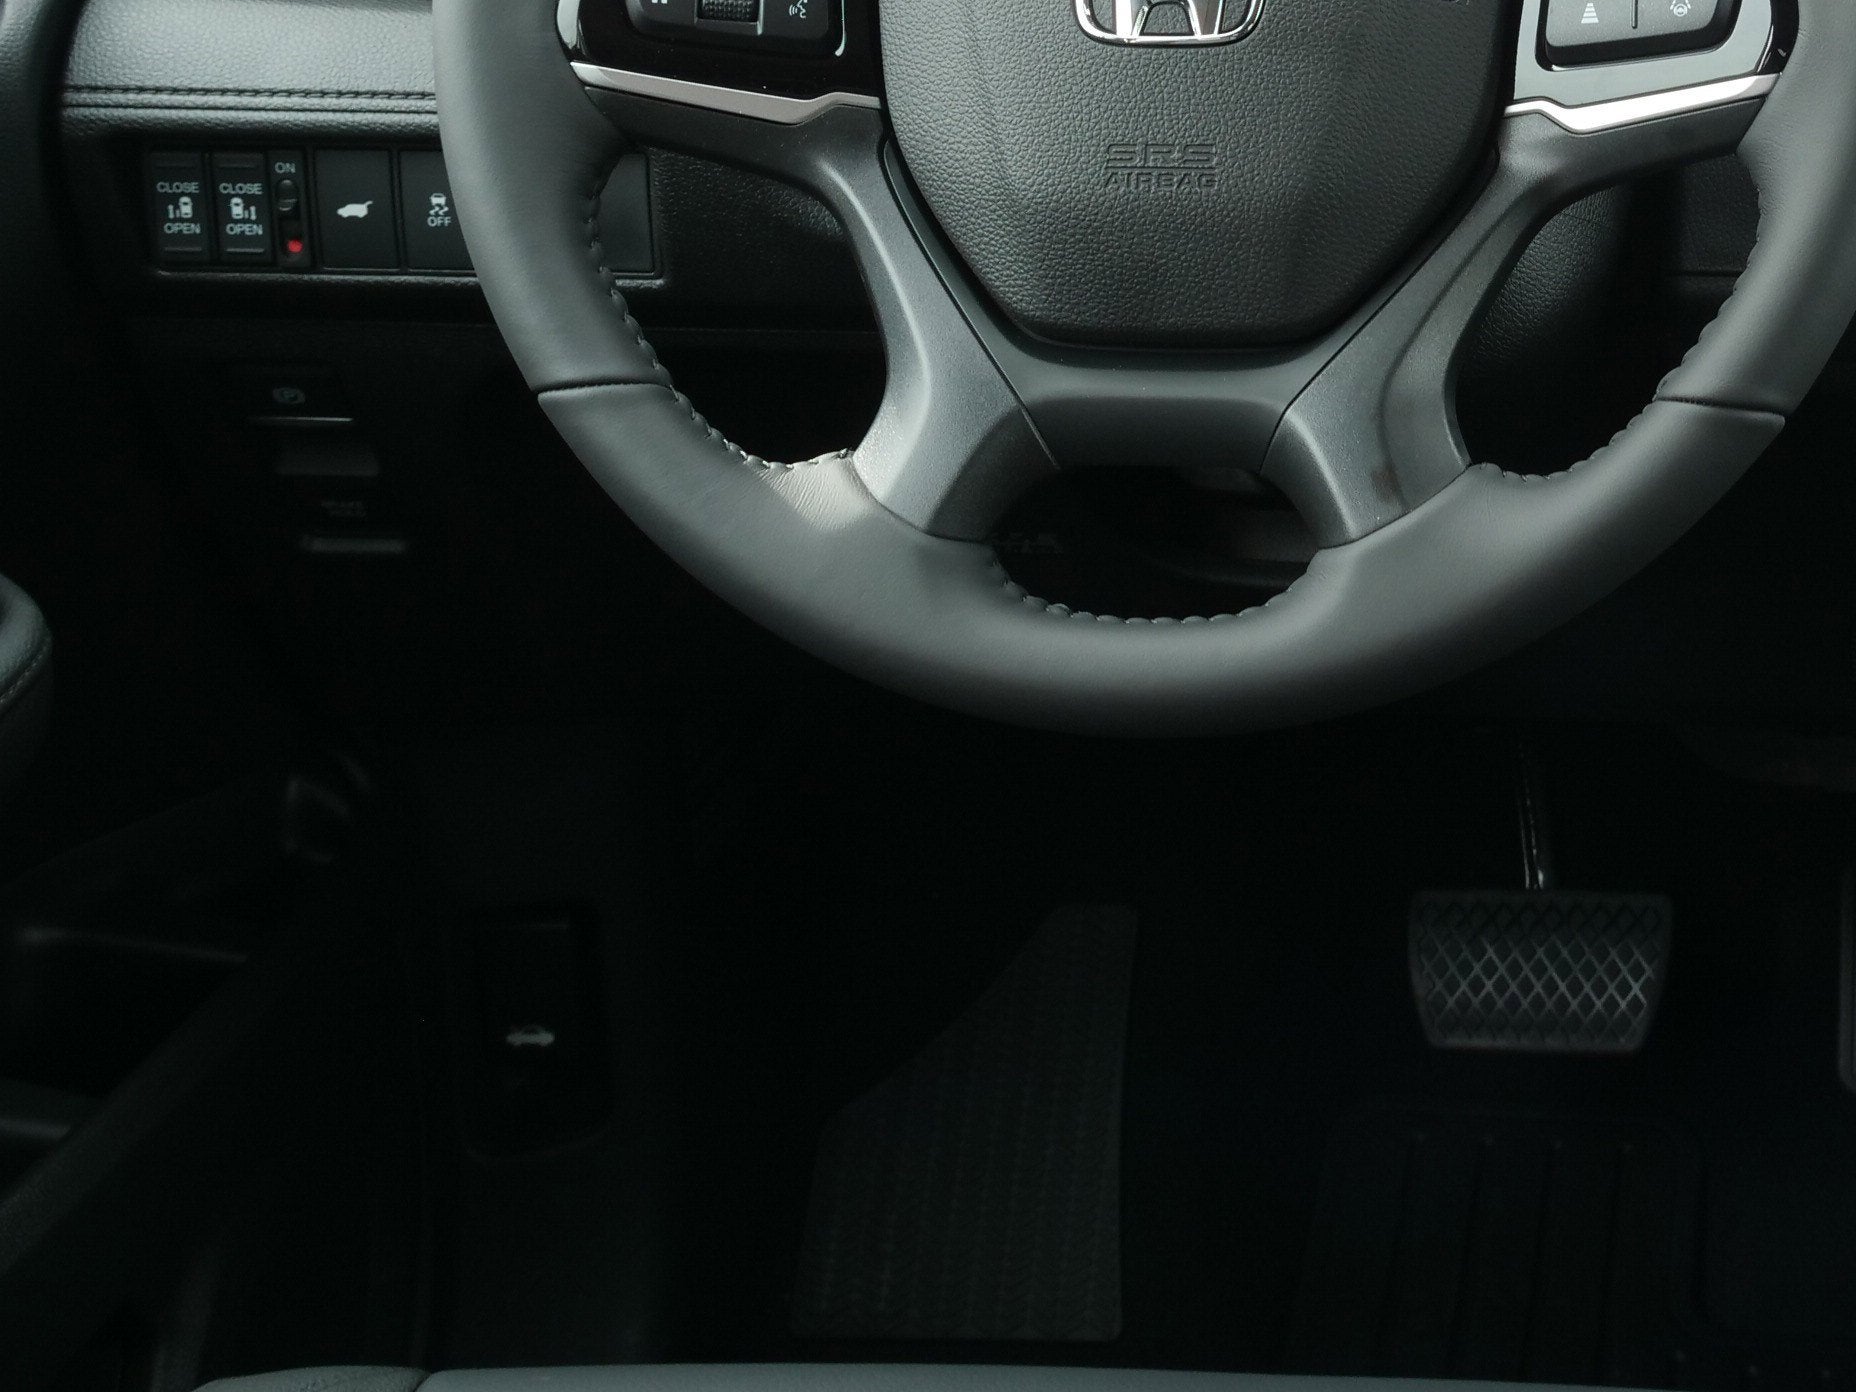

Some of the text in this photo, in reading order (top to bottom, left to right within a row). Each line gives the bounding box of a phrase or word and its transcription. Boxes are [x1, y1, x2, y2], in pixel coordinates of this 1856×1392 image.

[274, 161, 297, 174] ON
[156, 181, 200, 194] CLOSE
[1104, 171, 1219, 192] AIRBAG
[219, 182, 263, 195] CLOSE
[427, 216, 452, 227] OFF
[163, 223, 202, 235] OPEN
[225, 223, 263, 236] OPEN
